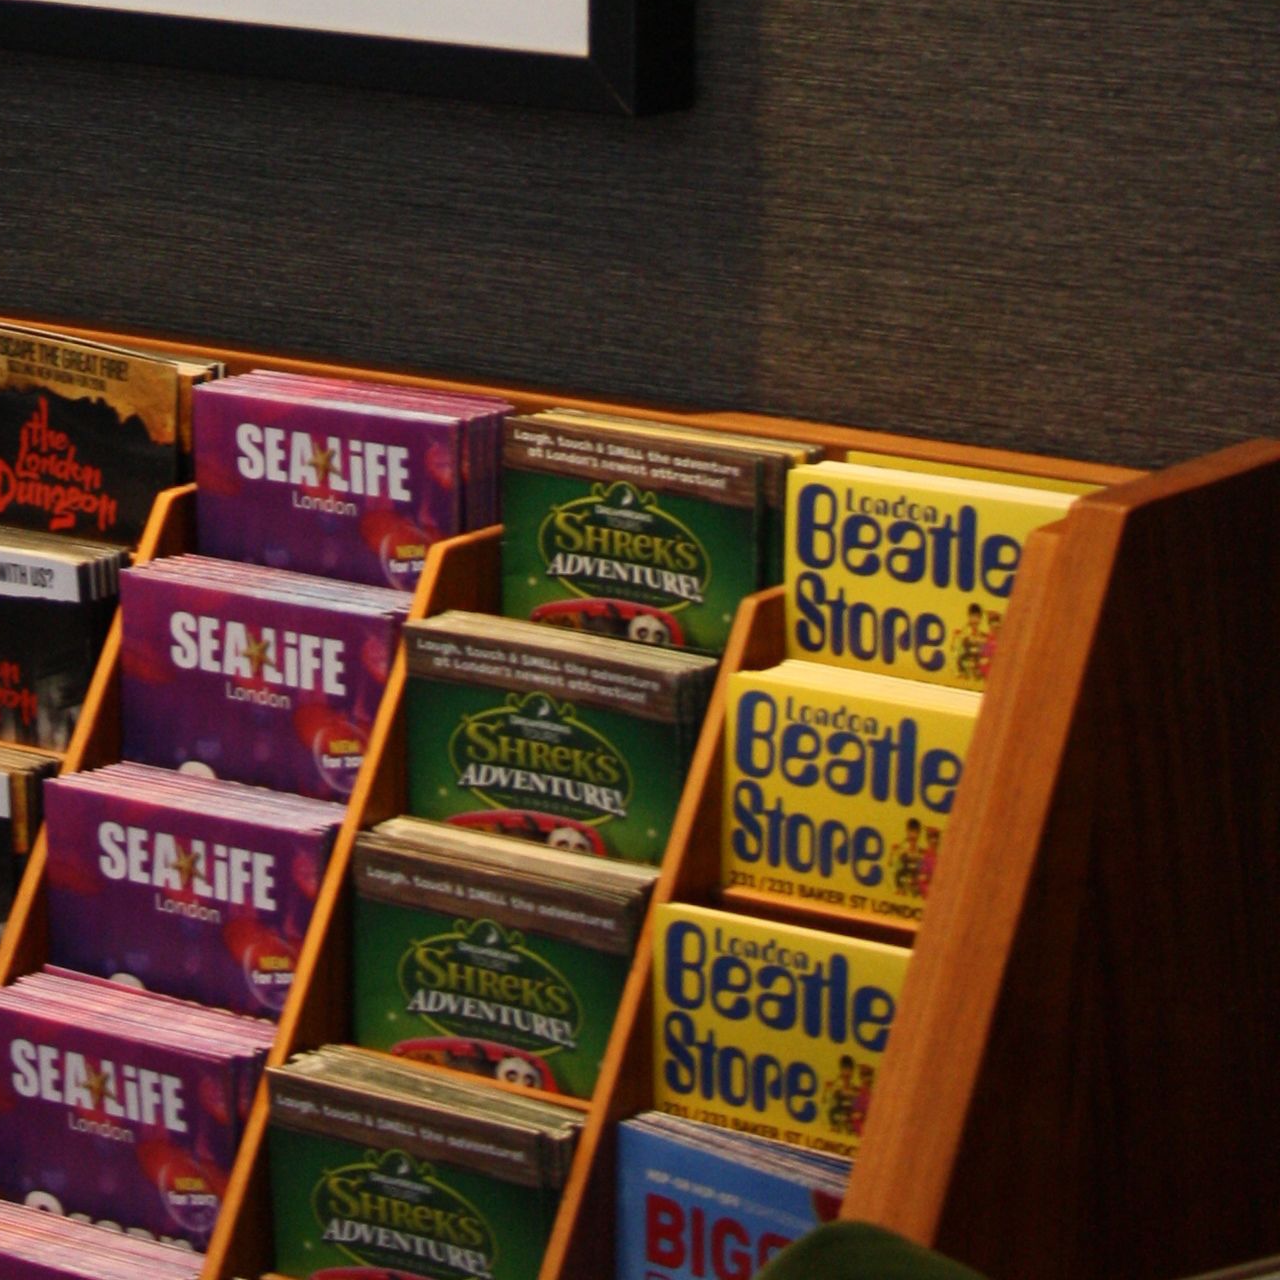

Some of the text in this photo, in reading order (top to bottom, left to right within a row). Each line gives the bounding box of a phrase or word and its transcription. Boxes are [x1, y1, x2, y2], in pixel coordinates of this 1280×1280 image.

[16, 423, 102, 489] London
[236, 423, 320, 487] SEA
[292, 491, 357, 517] London
[846, 488, 937, 523] London
[546, 552, 704, 603] ADVENTURE!
[170, 611, 253, 678] SEA
[796, 571, 946, 672] Store
[225, 681, 292, 710] London
[786, 696, 878, 735] London
[457, 762, 627, 818] ADVENTURE!
[98, 821, 183, 891] SEA
[732, 779, 885, 887] Store
[154, 892, 221, 923] London
[728, 870, 756, 887] 231
[797, 885, 845, 904] BAKER
[849, 894, 867, 908] ST
[715, 927, 810, 970] London
[406, 988, 578, 1049] ADVENTURE!
[10, 1038, 95, 1110] SEA
[664, 1010, 818, 1124] Store
[68, 1112, 136, 1144] London
[323, 1218, 494, 1279] ADVENTURE!
